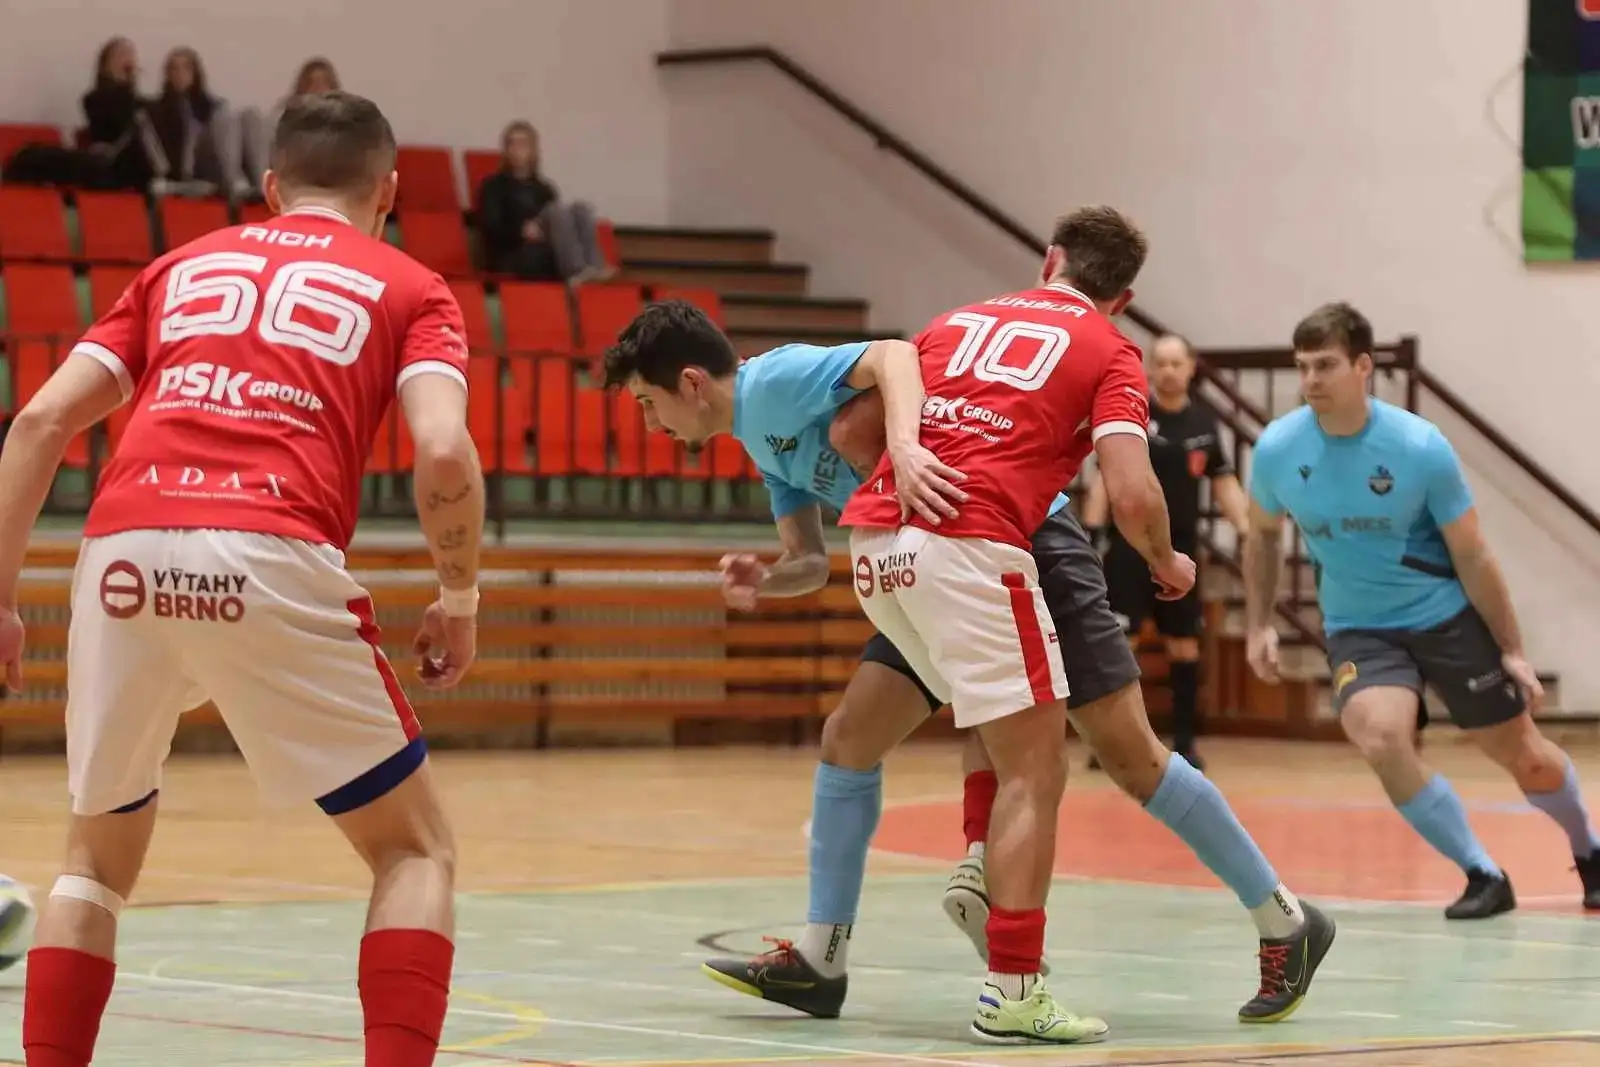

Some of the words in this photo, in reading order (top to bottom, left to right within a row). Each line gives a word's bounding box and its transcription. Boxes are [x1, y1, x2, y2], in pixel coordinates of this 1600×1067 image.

[240, 226, 333, 249] RICH
[160, 251, 387, 366] 56
[944, 311, 1071, 391] 10
[155, 362, 253, 407] PSK
[248, 380, 324, 411] GROUP
[921, 396, 968, 422] SK
[962, 404, 1014, 430] GROUP
[154, 591, 245, 623] BRNO
